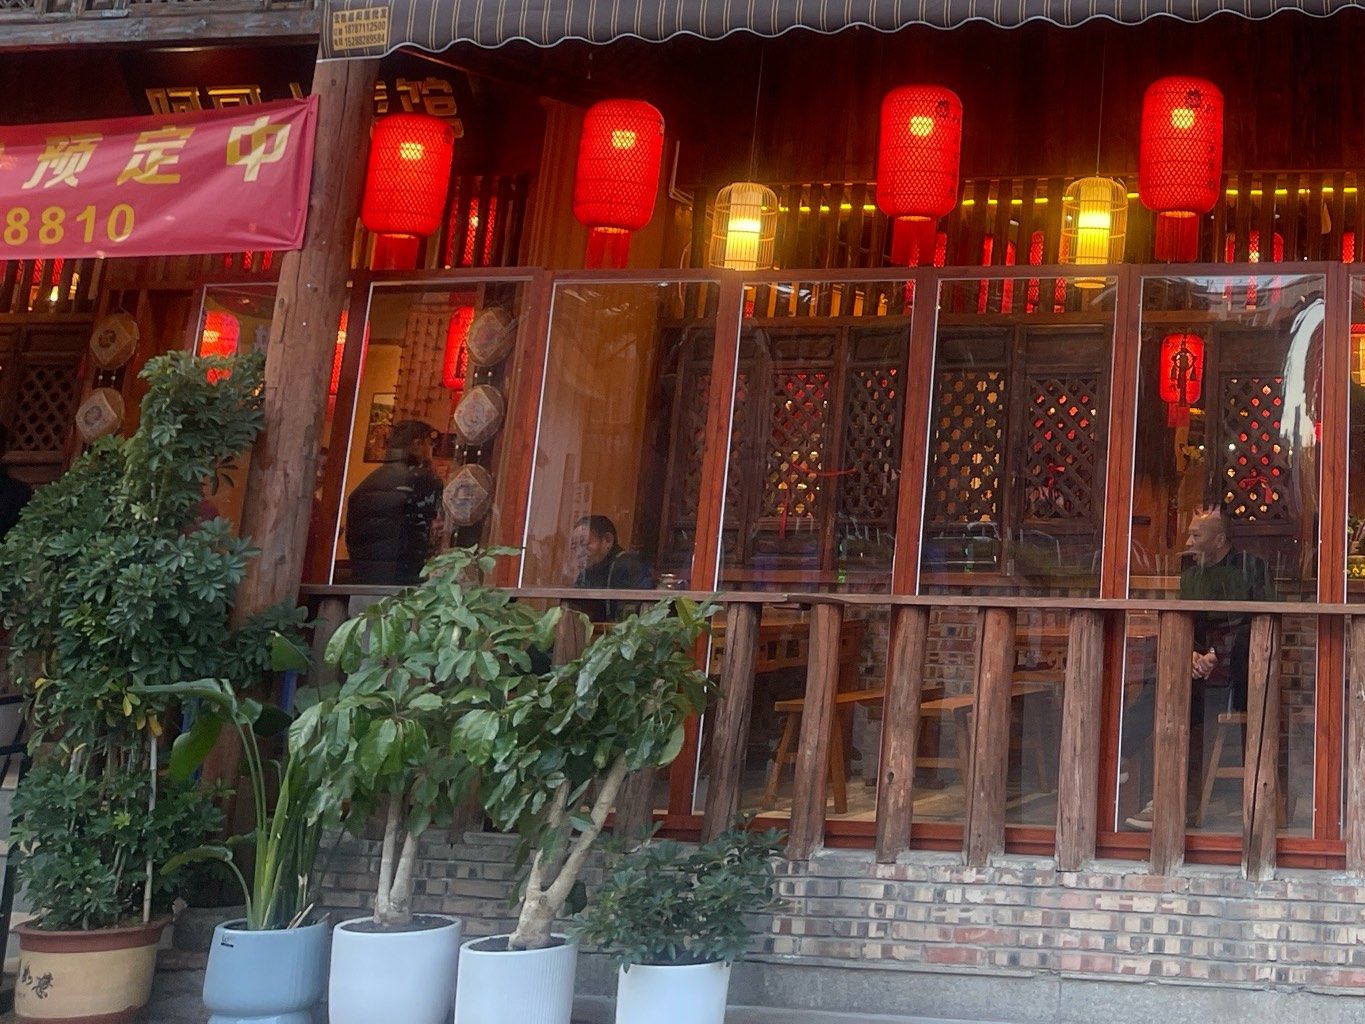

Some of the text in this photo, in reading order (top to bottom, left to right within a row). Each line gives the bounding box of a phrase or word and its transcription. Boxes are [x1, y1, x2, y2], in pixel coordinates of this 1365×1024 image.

[0, 116, 292, 189] 预定中
[3, 203, 135, 246] 8810
